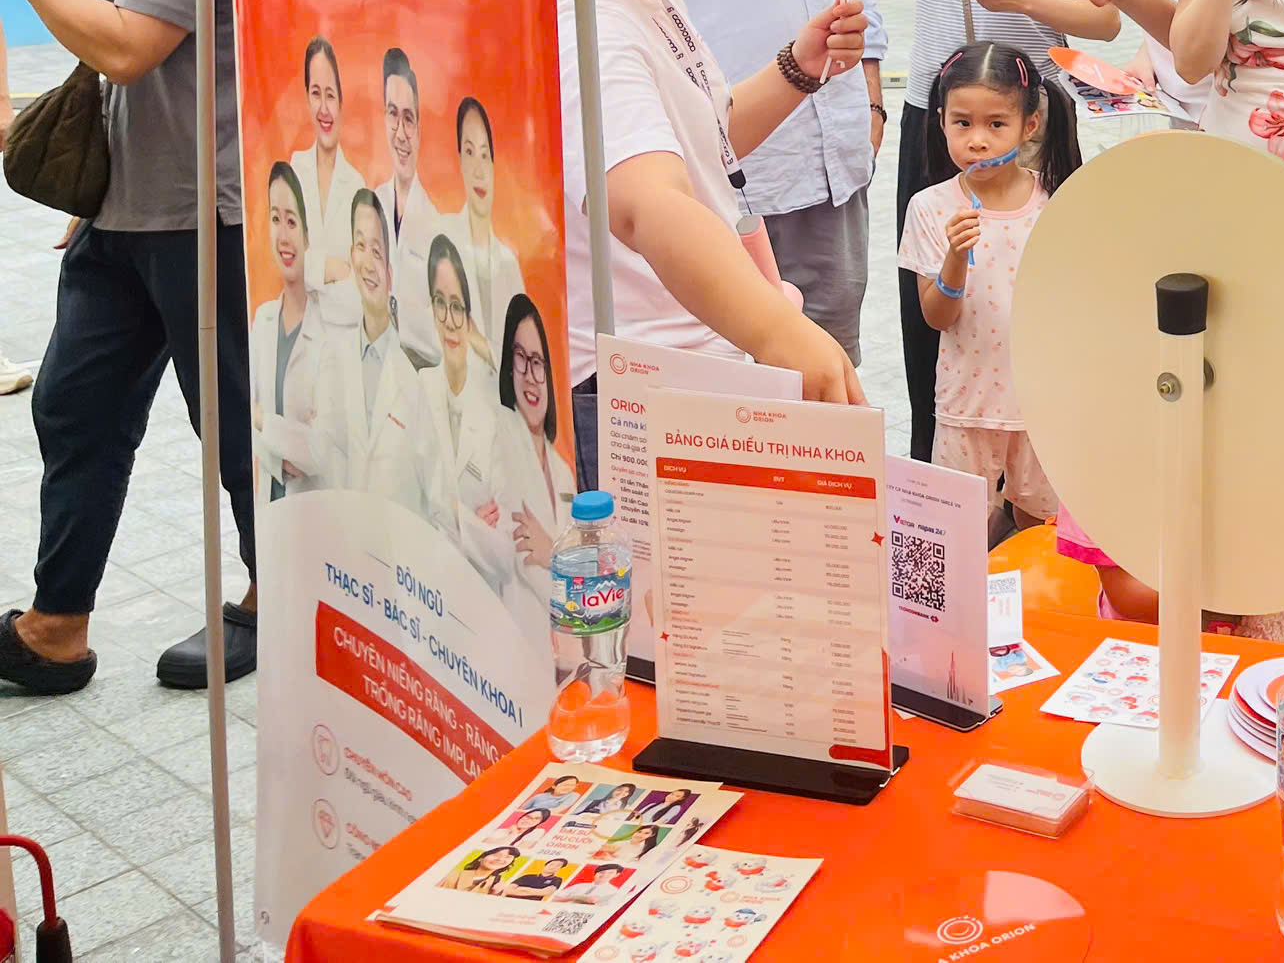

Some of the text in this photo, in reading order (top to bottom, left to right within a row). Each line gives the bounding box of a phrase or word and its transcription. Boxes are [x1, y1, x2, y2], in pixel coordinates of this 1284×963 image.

[665, 429, 866, 463] BẢNG GIÁ ĐIỀU TRỊ NHA KHOA
[396, 564, 443, 617] ĐỘI NGŨ
[325, 562, 359, 598] THẠC
[362, 582, 374, 608] SĨ
[384, 597, 407, 630] BÁC
[409, 616, 420, 643] SĨ
[429, 635, 479, 691] CHUYÊN
[480, 676, 517, 723] KHOA
[333, 626, 385, 674] CHUYÊN
[425, 688, 457, 730] RĂNG
[465, 722, 499, 765] RĂNG
[362, 674, 407, 719] TRỒNG
[408, 706, 441, 747] RĂNG
[949, 923, 1036, 961] KHOA ORION
